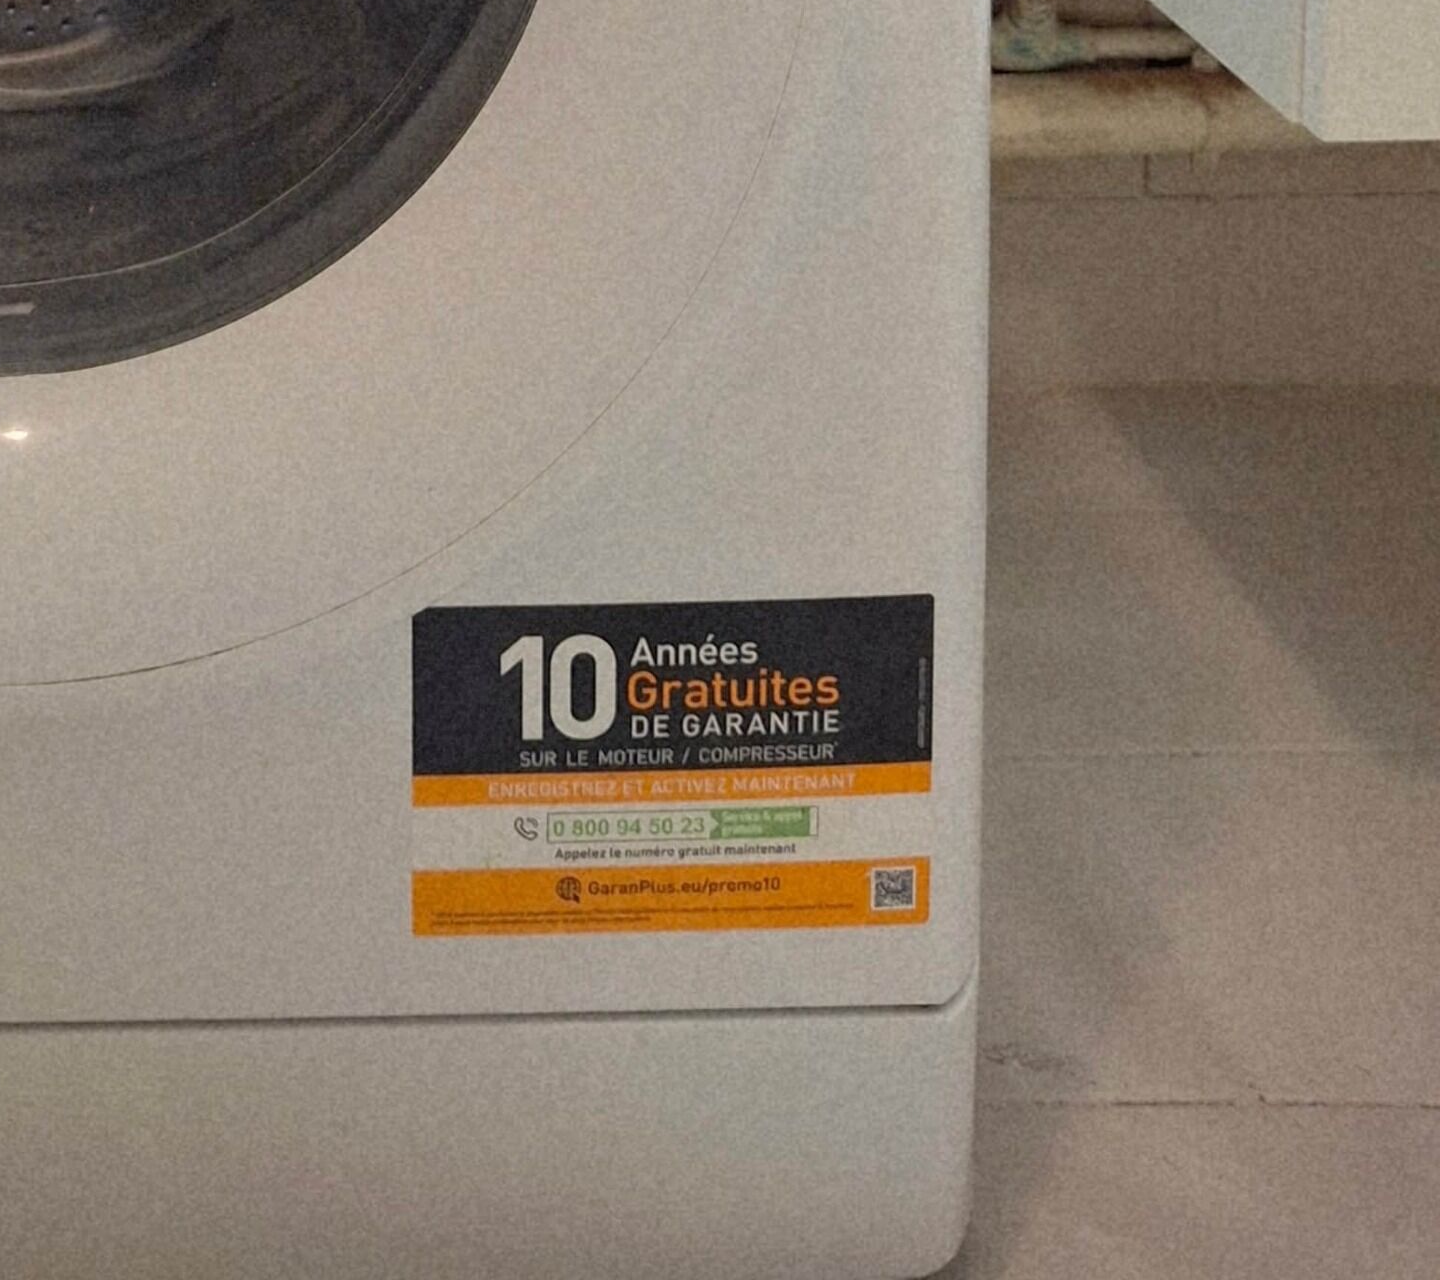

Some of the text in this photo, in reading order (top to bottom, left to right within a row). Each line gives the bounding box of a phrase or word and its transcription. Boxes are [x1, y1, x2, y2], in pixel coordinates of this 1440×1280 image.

[630, 634, 759, 667] Années
[499, 633, 618, 741] 10
[627, 668, 841, 710] Gratuites
[631, 710, 841, 739] DE GARANTIE
[520, 750, 557, 768] SUR
[566, 749, 589, 767] LE
[598, 747, 674, 766] MOTEUR
[681, 747, 690, 765] /
[488, 772, 857, 799] ENREGISTREZ ET ACTIVEZ MAINTENANT
[552, 819, 565, 836] 0
[572, 819, 609, 836] 800
[616, 818, 642, 835] 94
[649, 817, 674, 835] 50
[680, 816, 705, 834] 23
[555, 843, 796, 861] Appelez le numéro gratuit maintenant
[588, 876, 781, 896] GaranPlus.eu/promo10
